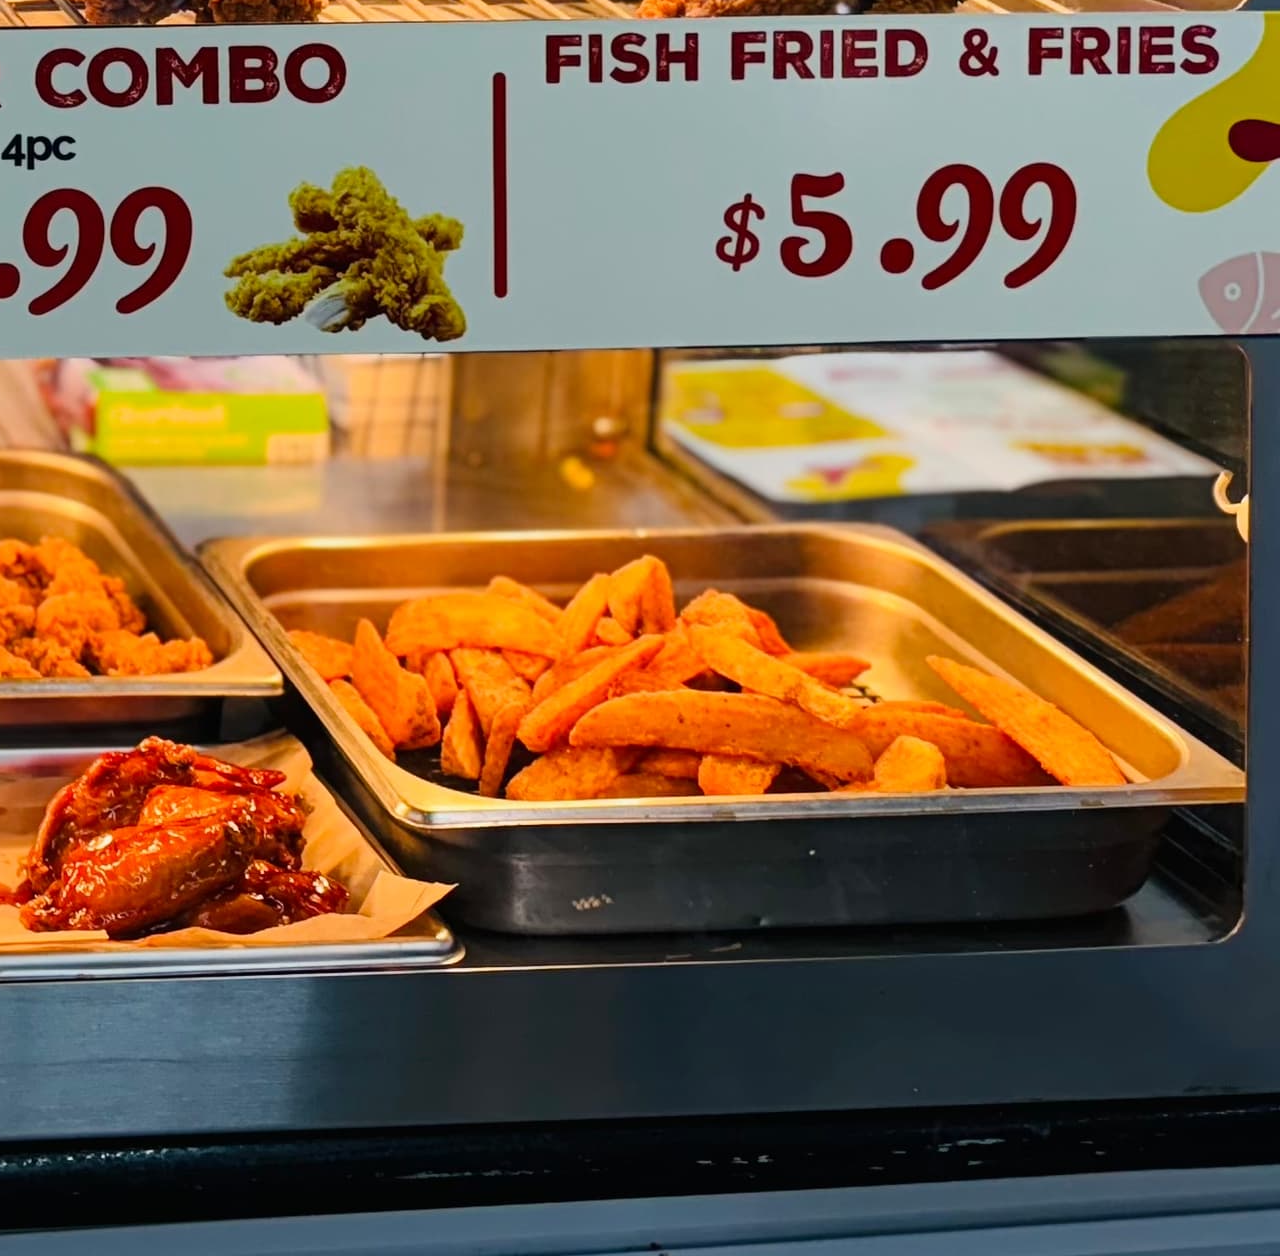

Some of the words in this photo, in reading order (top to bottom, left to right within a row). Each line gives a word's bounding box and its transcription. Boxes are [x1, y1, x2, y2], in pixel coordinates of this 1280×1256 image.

[34, 42, 347, 109] COMBO
[545, 32, 699, 85] FISH
[730, 28, 929, 81] FRIED
[958, 27, 1000, 78] &
[1027, 24, 1220, 76] FRIES
[0, 132, 78, 171] 4pc
